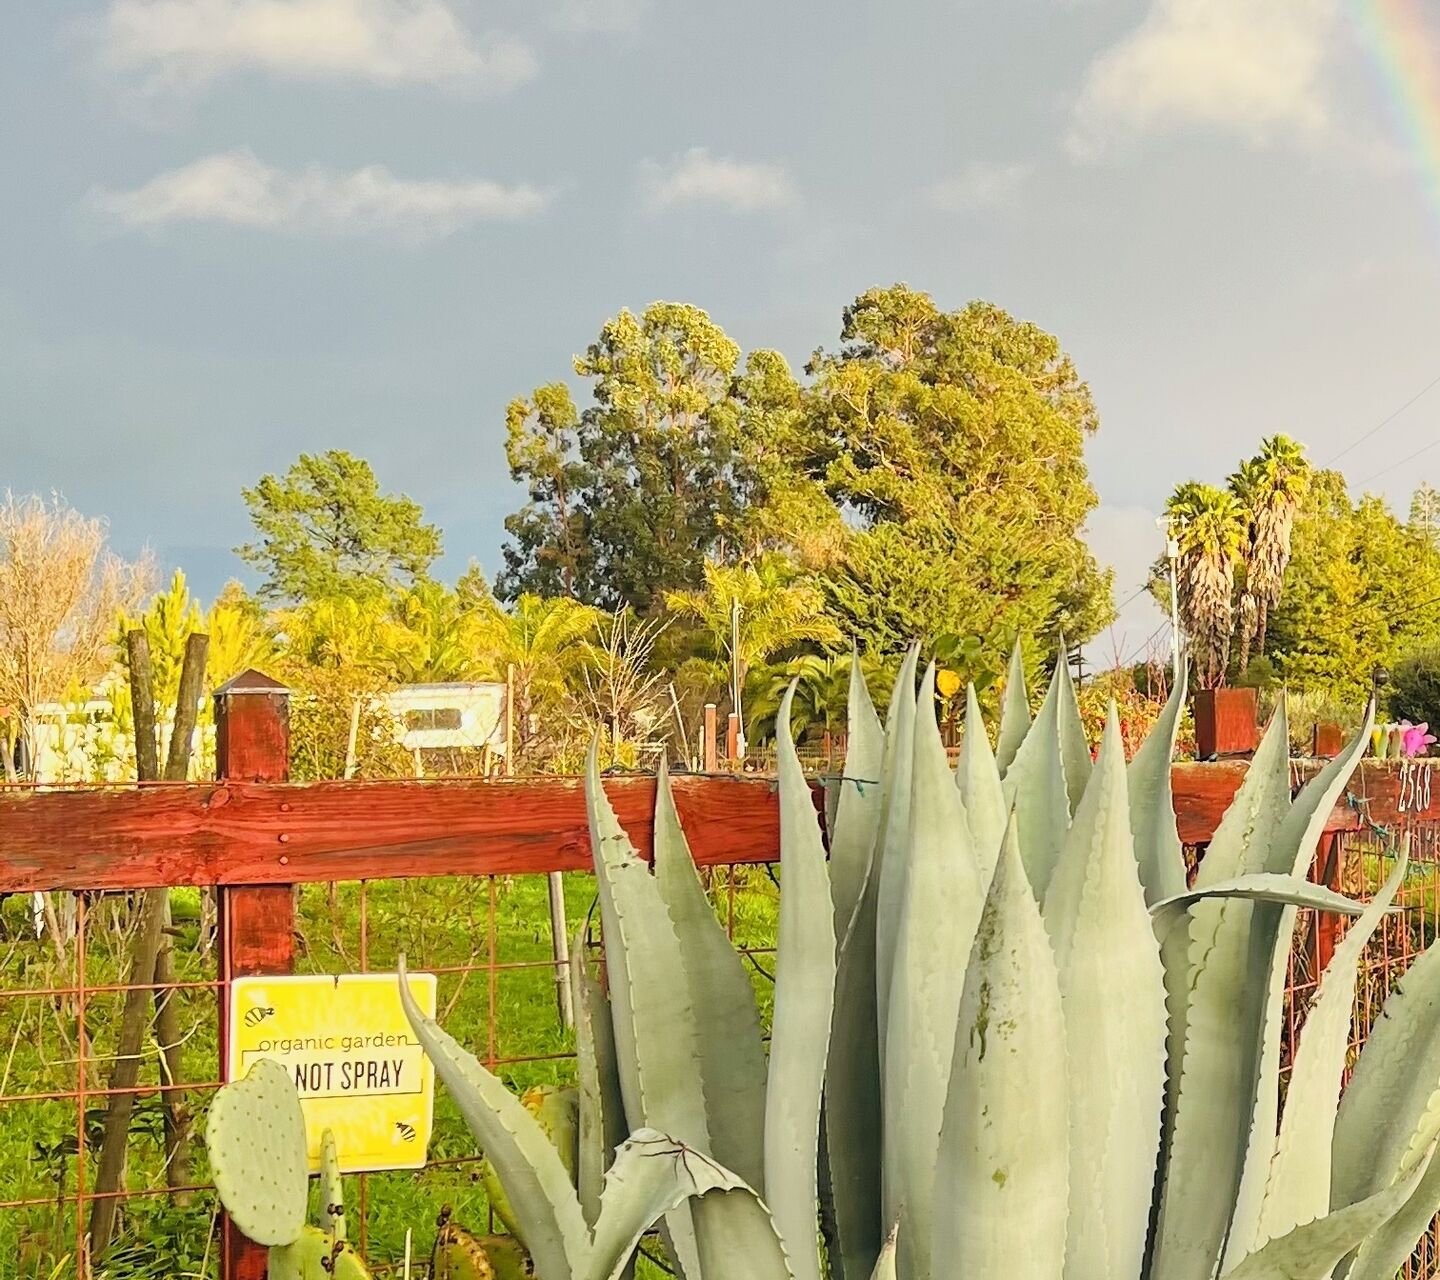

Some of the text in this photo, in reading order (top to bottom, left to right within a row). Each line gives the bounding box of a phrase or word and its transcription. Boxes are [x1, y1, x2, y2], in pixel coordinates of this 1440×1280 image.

[1398, 763, 1431, 812] 2568
[258, 1032, 408, 1055] organic garden
[295, 1059, 404, 1091] NOT SPRAY
